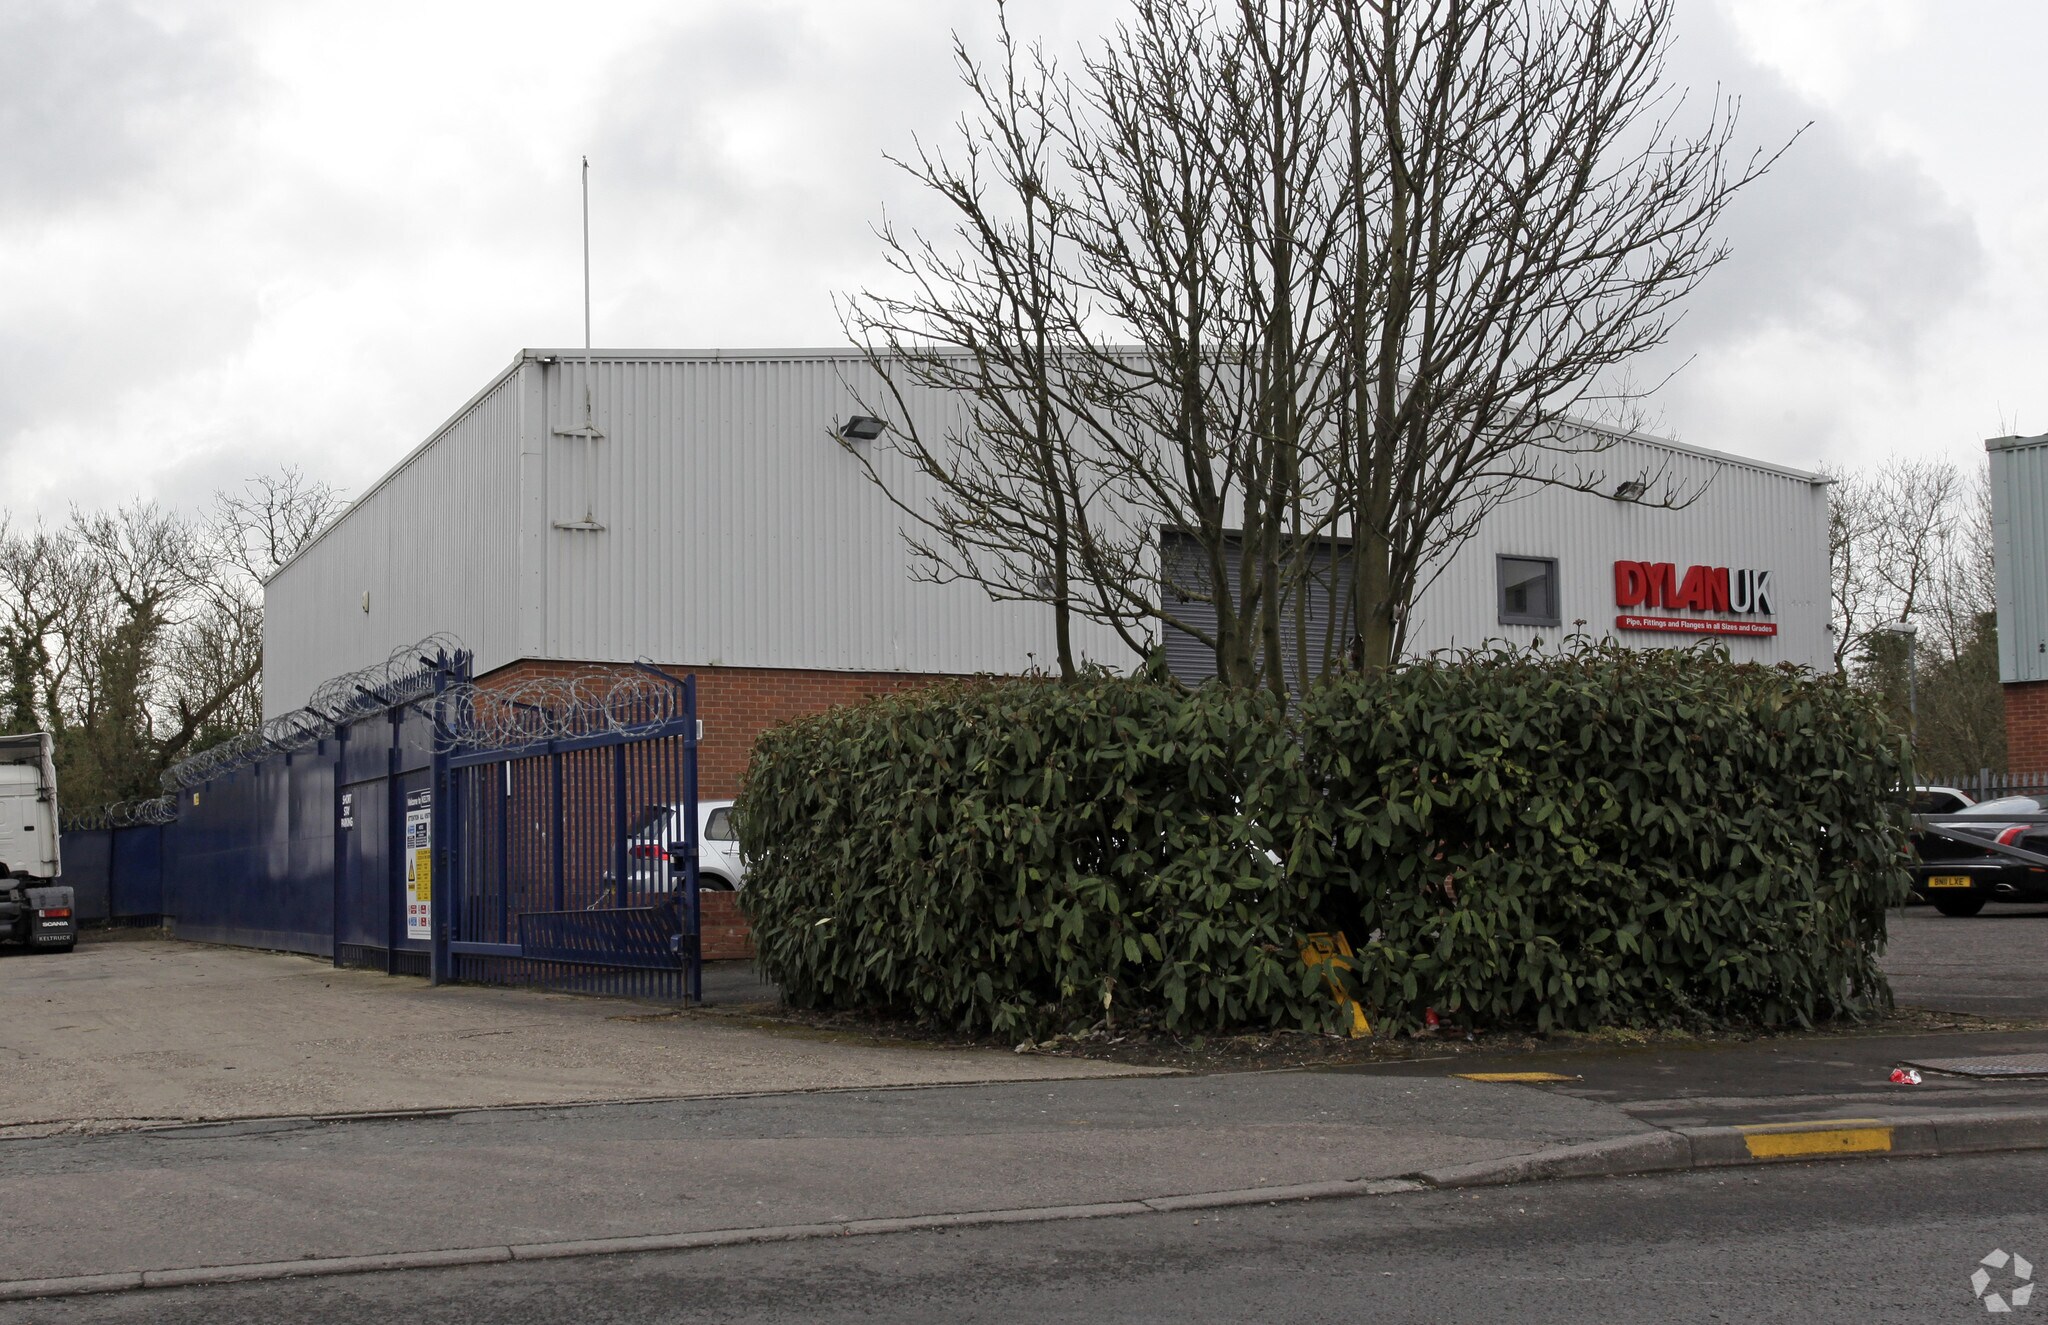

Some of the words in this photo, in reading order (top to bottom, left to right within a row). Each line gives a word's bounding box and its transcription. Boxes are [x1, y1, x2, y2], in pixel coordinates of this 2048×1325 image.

[1626, 617, 1642, 627] Pipe,
[1643, 618, 1666, 629] Fittings
[1681, 621, 1705, 630] Flanges
[1721, 622, 1738, 631] Sizes
[1751, 624, 1772, 633] Grades
[1949, 877, 1964, 886] LXE
